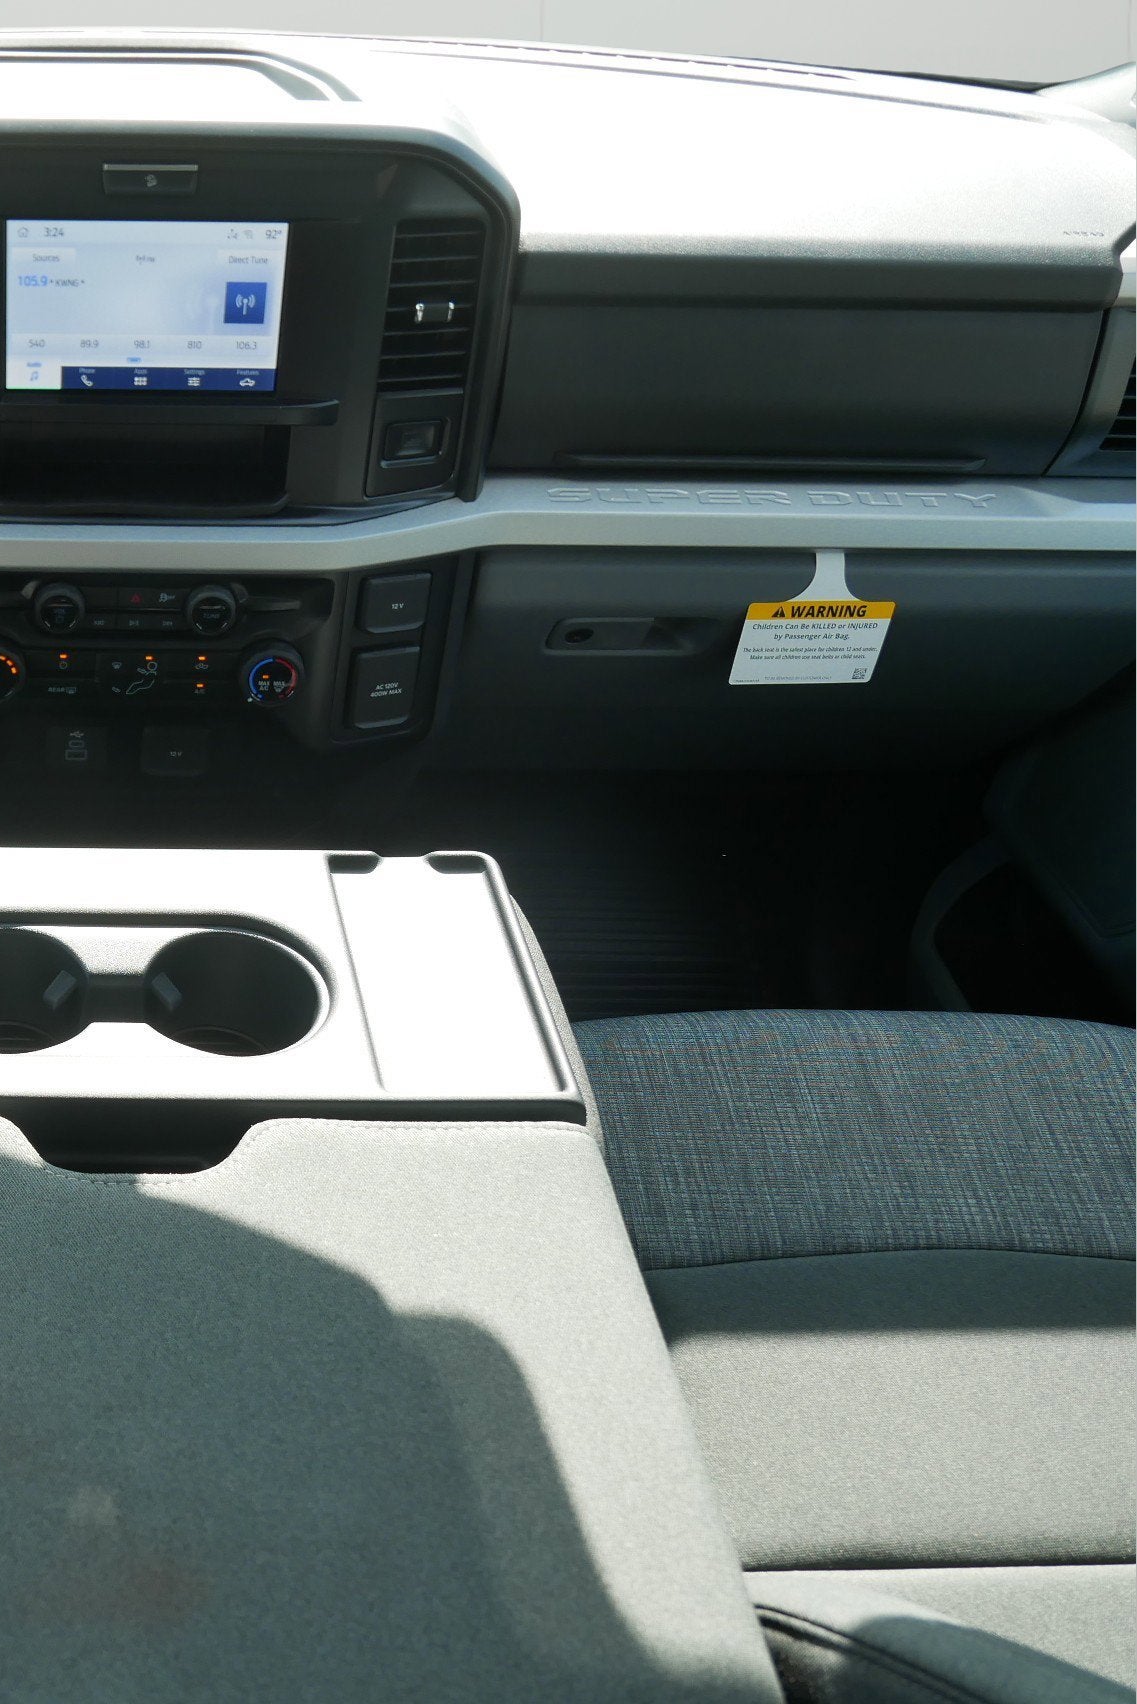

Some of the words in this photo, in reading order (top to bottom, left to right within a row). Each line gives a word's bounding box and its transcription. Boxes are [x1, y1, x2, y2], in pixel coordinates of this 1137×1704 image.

[44, 227, 64, 237] 3:24
[32, 254, 61, 263] Sources
[228, 256, 249, 264] Direct
[251, 256, 268, 265] Tune
[18, 275, 48, 287] 105.9
[28, 340, 45, 348] 540
[80, 340, 99, 348] 89.9
[133, 340, 150, 349] 98.1
[187, 341, 202, 349] 810
[236, 341, 257, 350] 106.3
[547, 487, 793, 506] SUPER
[807, 490, 997, 509] DUTY
[790, 605, 868, 618] WARNING
[811, 622, 837, 630] KILLED
[847, 622, 879, 631] INJURED
[773, 633, 783, 641] by
[784, 633, 821, 641] Passenger
[835, 633, 850, 641] Bag.
